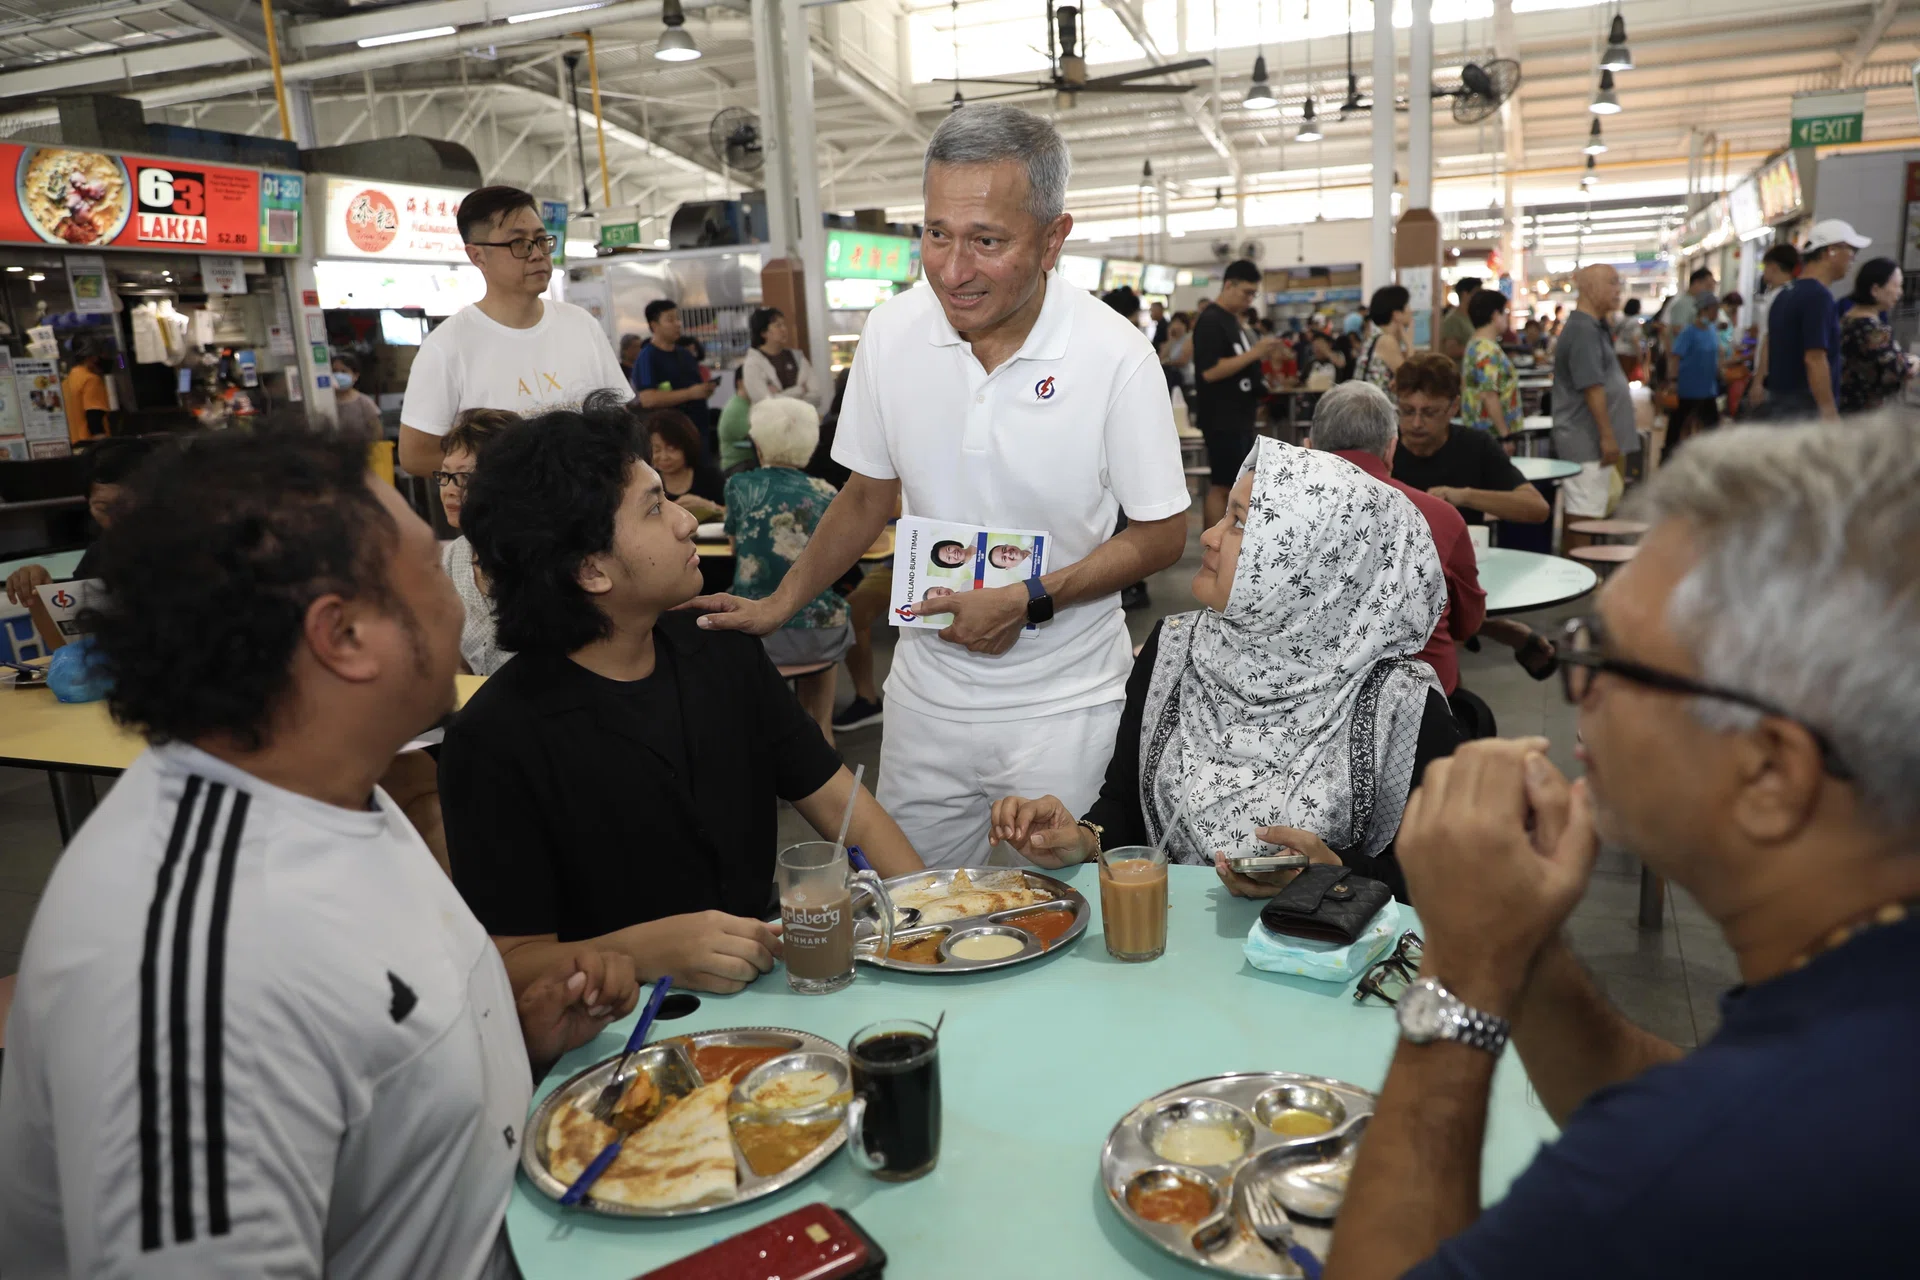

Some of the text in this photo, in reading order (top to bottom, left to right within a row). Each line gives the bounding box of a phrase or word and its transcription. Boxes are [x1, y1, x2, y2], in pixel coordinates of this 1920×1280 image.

[1811, 117, 1857, 143] EXIT
[138, 168, 204, 216] 63
[264, 178, 301, 198] 01-20
[138, 215, 205, 241] LAKSA
[906, 529, 919, 603] HOLLAND-BUKIT TIMAH
[781, 906, 840, 925] arlsberg
[785, 932, 828, 944] DENMARK
